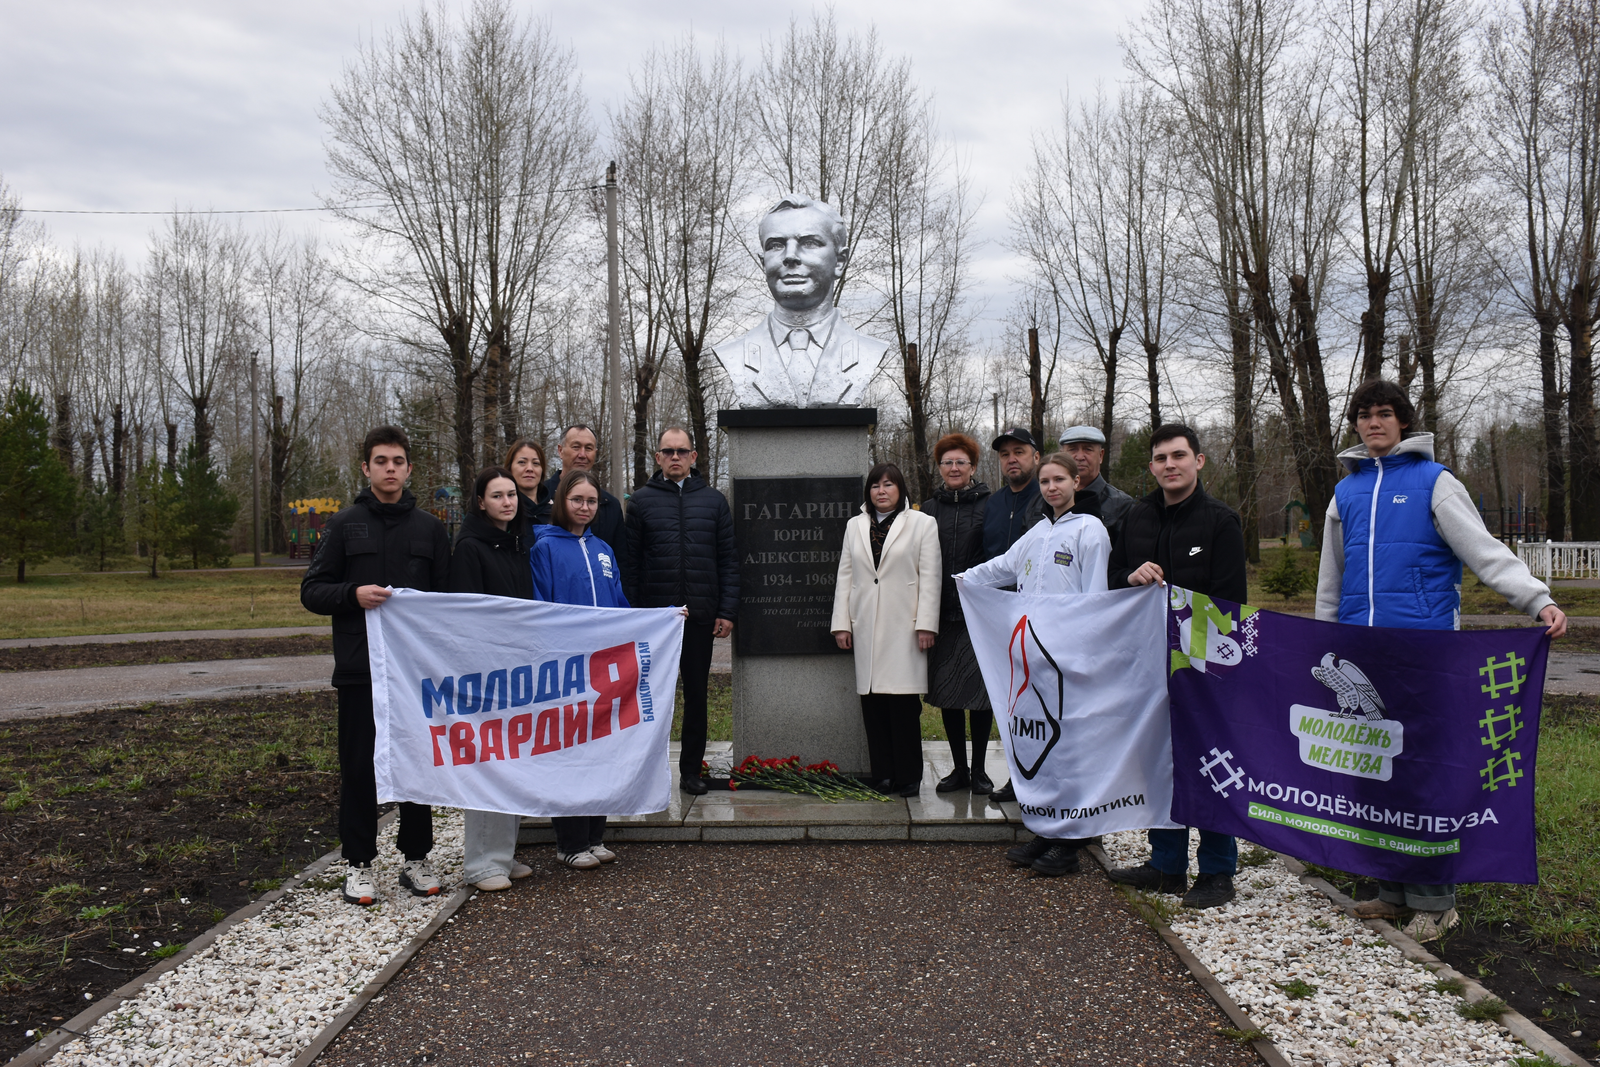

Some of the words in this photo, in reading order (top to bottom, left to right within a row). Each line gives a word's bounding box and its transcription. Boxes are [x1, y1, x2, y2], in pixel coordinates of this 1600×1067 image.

[743, 502, 853, 520] ГАГАРИН
[773, 526, 824, 541] ЮРИЙ
[744, 551, 841, 564] АЛЕКСЕЕВИ
[763, 574, 792, 586] 1934
[805, 573, 835, 585] 1968
[815, 595, 835, 603] ЧЕЛО
[638, 641, 655, 722] БАШКОРТОСТАН
[1298, 715, 1393, 749] МОЛОДЁЖЬ
[1308, 744, 1384, 775] МЕЛЕУЗА
[1060, 794, 1145, 820] ПОЛИТИКИ
[1248, 804, 1283, 823] Сила
[1285, 816, 1360, 841] молодости
[1378, 837, 1386, 847] в
[1389, 838, 1460, 855] единстве!
